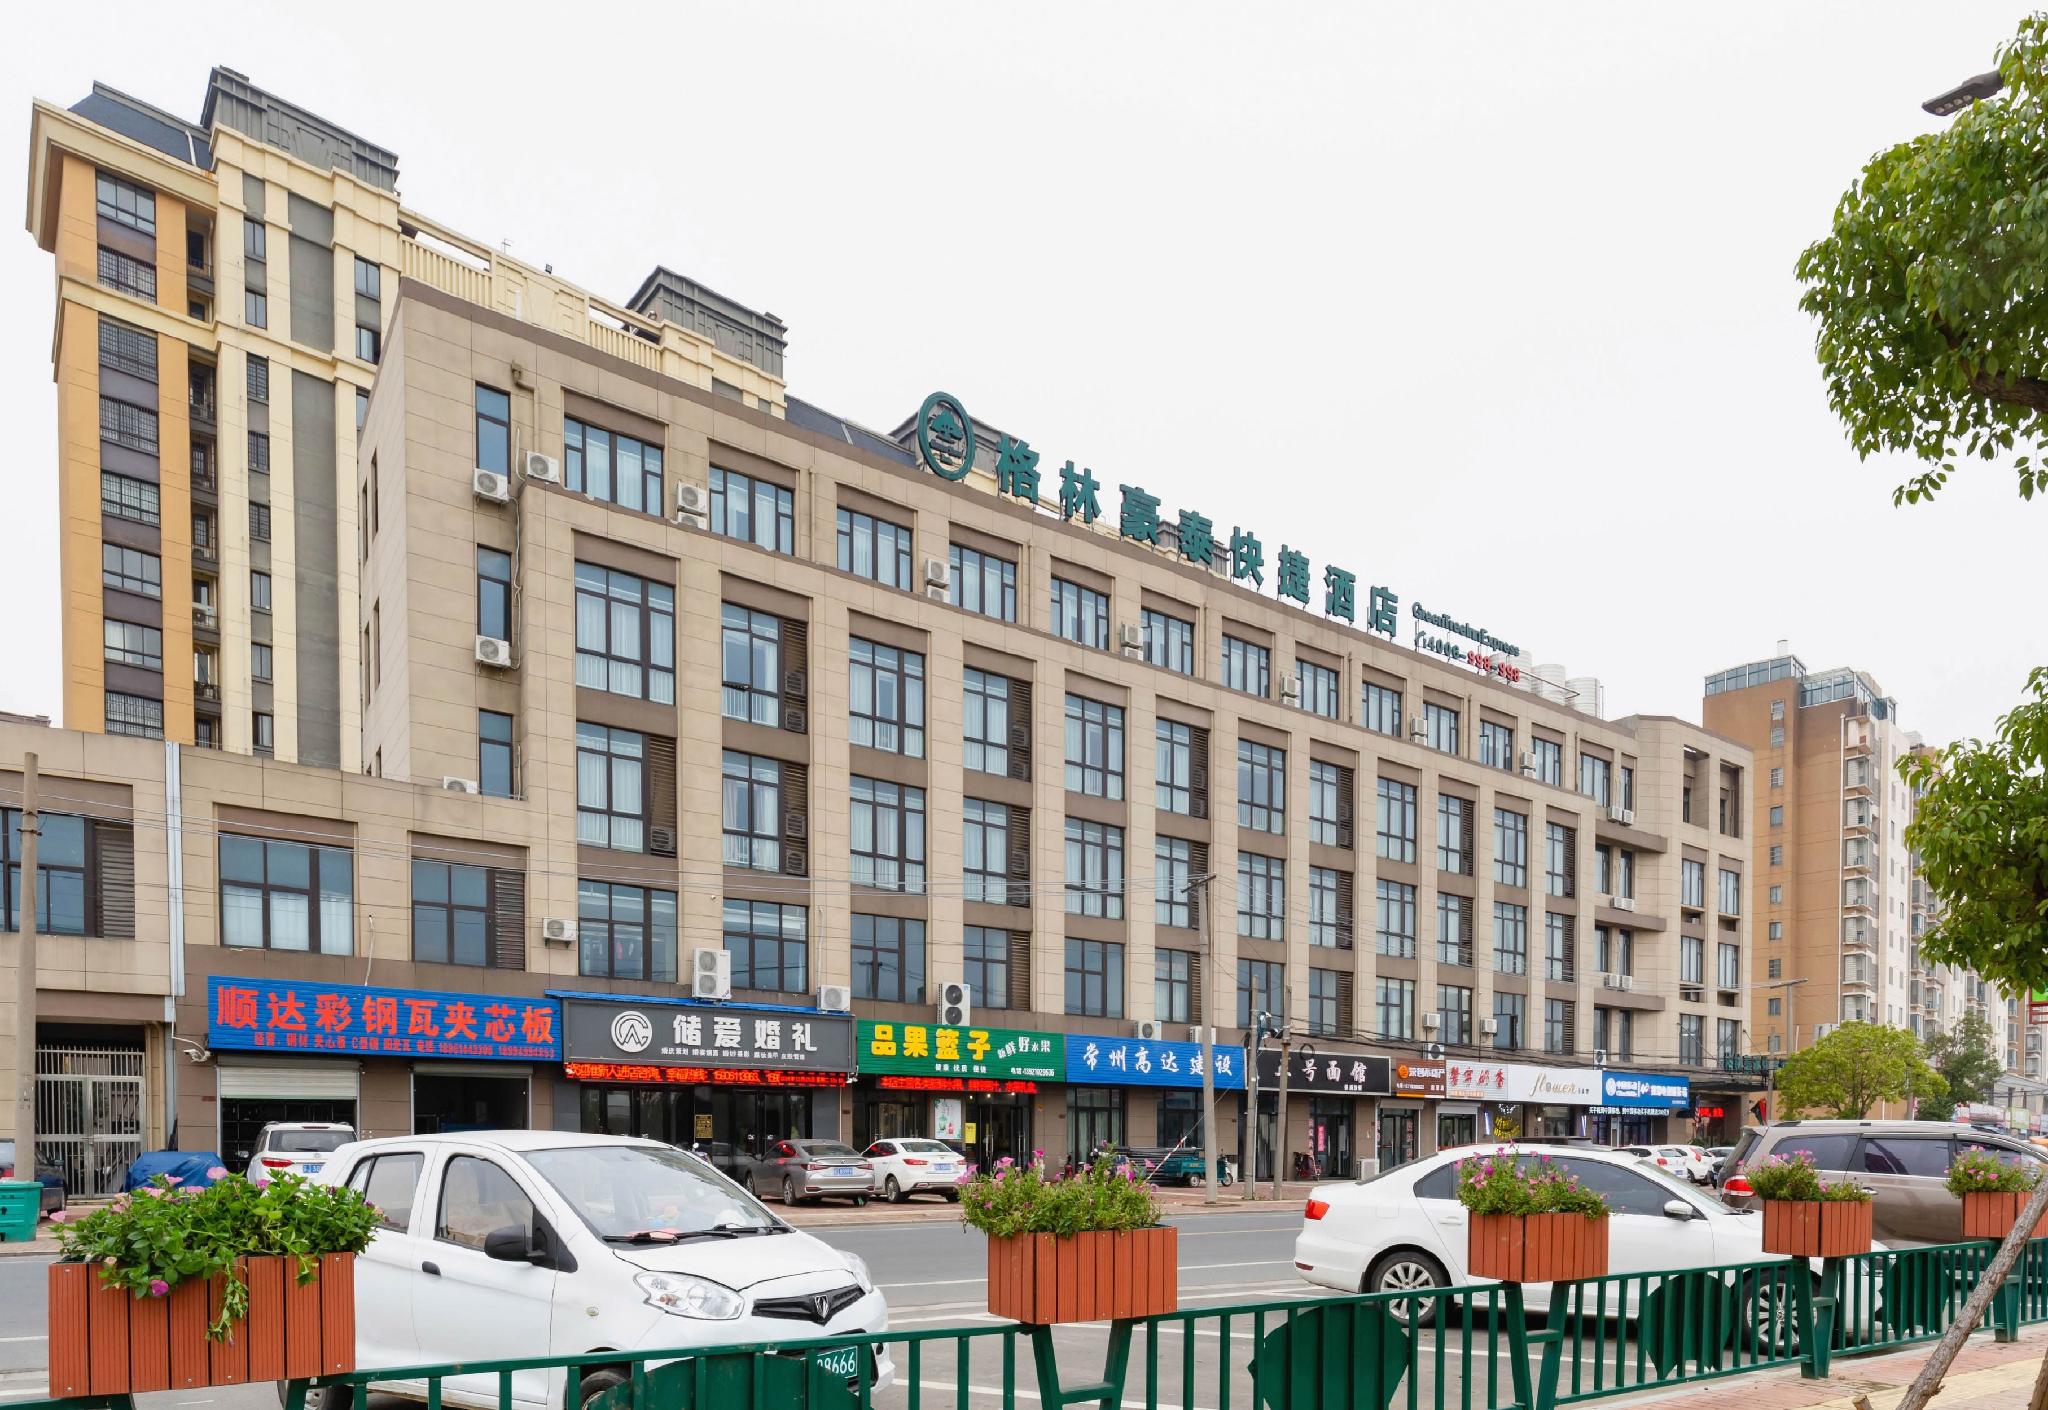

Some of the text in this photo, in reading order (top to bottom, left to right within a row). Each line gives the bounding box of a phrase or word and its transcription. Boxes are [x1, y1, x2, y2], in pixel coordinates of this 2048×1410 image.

[995, 433, 1399, 638] 格林豪泰快捷酒店
[216, 984, 554, 1044] 顺达彩钢瓦夹芯板
[672, 1014, 818, 1052] 储爱婚礼
[870, 1024, 992, 1060] 品果篮子
[997, 1035, 1051, 1060] 新鲜好水果
[1082, 1044, 1233, 1077] 常州高达建设
